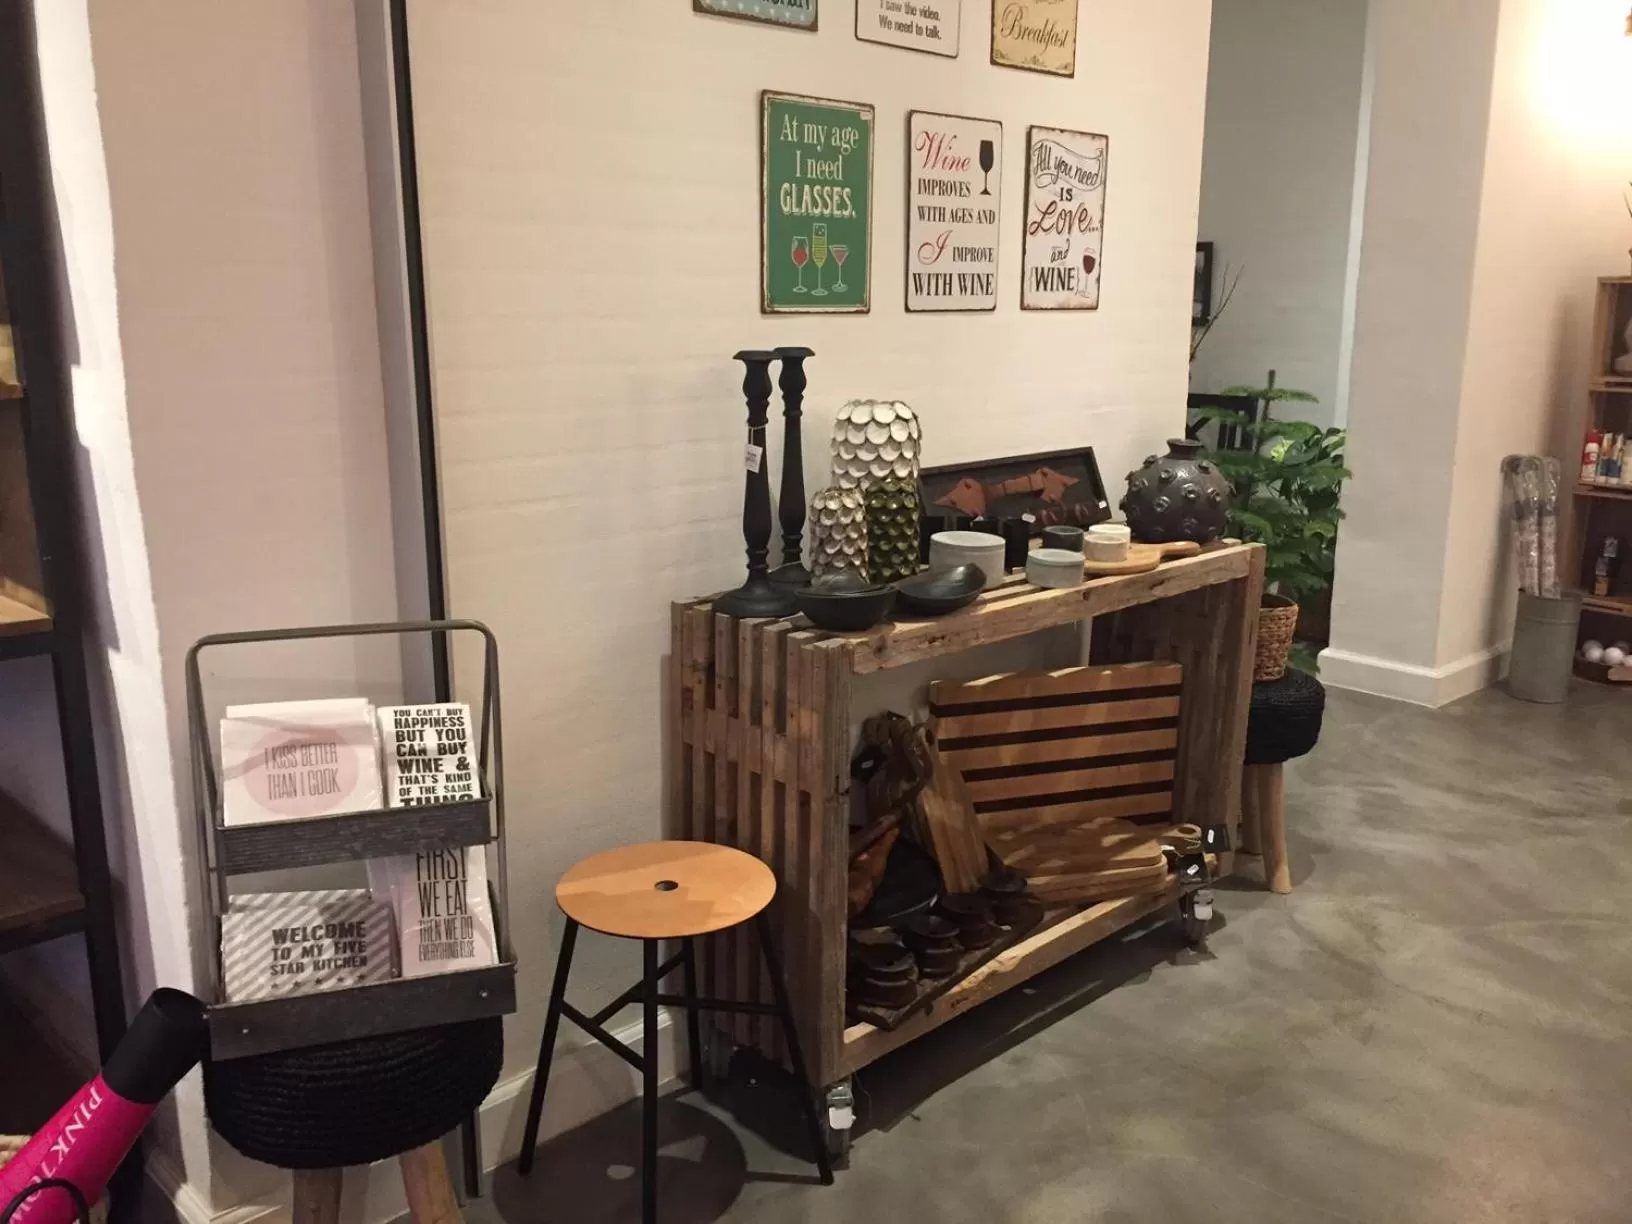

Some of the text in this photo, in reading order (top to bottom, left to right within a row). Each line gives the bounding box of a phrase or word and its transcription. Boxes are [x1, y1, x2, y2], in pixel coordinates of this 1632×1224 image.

[904, 2, 917, 16] the
[920, 6, 941, 21] video.
[879, 14, 942, 40] We need to talk.
[1000, 2, 1069, 56] Breakfast
[780, 113, 859, 155] At my age
[915, 131, 971, 172] Wine
[796, 150, 843, 181] I need
[1033, 143, 1099, 186] All you need
[780, 182, 857, 218] GLASSES.
[917, 178, 971, 198] IMPROVES
[1060, 187, 1073, 202] IS
[917, 206, 995, 225] WITH AGES AND
[952, 246, 994, 263] IMPROVE
[1051, 238, 1071, 263] and
[913, 272, 994, 297] WITH WINE
[394, 708, 463, 718] YOU CAN'T BUY
[394, 716, 465, 729] HAPPINESS
[395, 728, 466, 742] BUT YOU
[264, 742, 338, 769] I KISS BETTER
[396, 741, 468, 757] CAN BUY
[396, 756, 471, 774] WINE &
[268, 768, 342, 800] THAN I COOK
[398, 772, 472, 785] THAT'S KIND
[399, 783, 472, 797] OF THE SAME
[418, 880, 467, 918] WE EAT
[272, 921, 366, 945] WELCOME
[419, 916, 473, 943] THEN WE DO
[272, 940, 366, 960] TO MY FIVE
[270, 956, 367, 976] STAR KITCHEN
[50, 1086, 103, 1164] PINK
